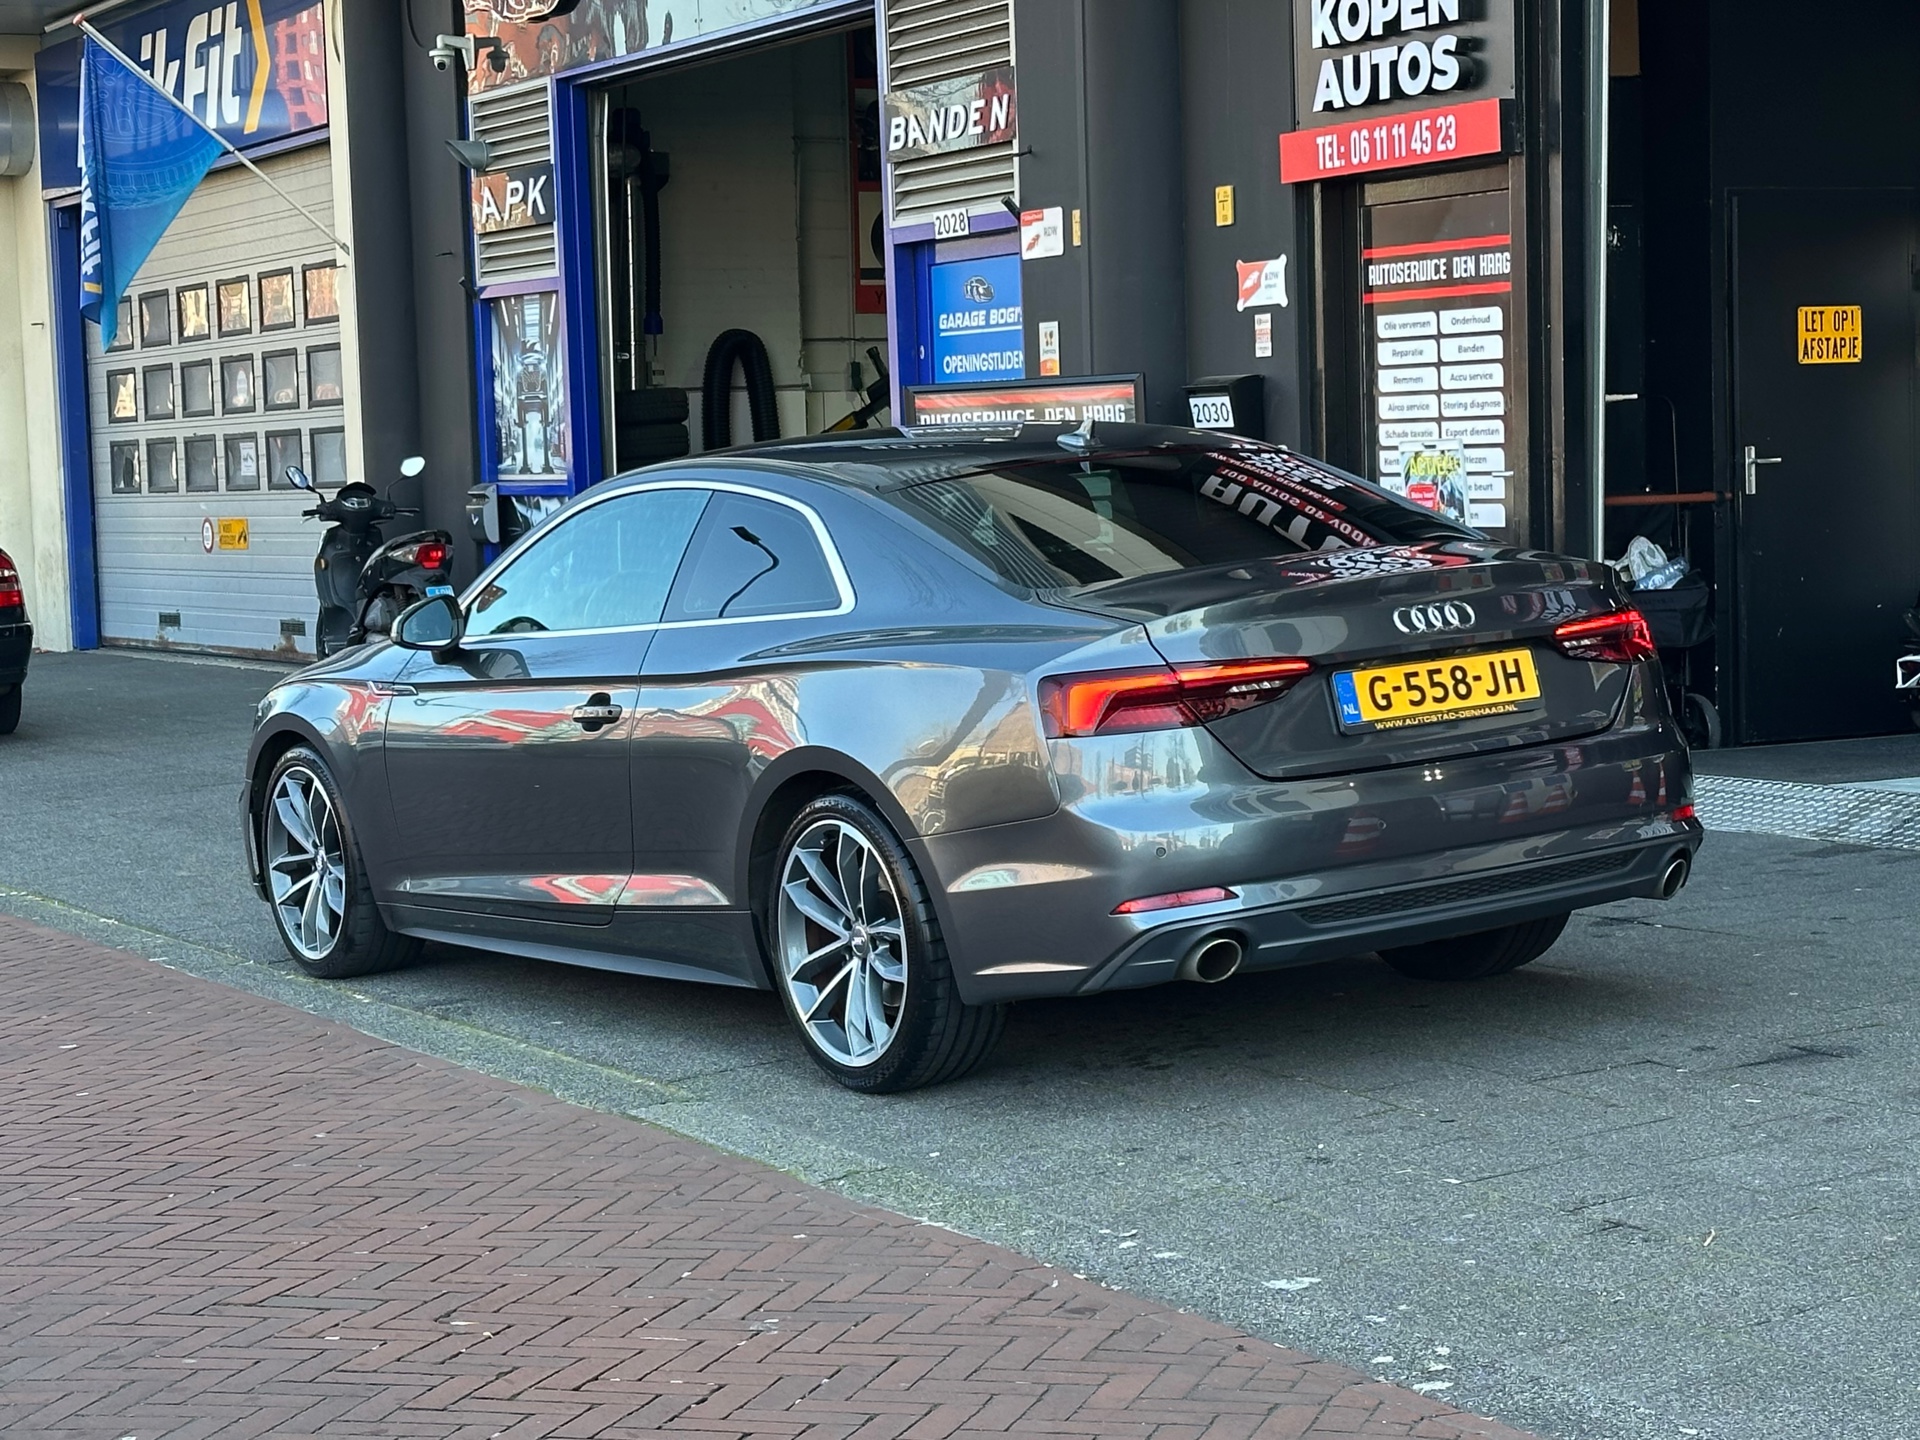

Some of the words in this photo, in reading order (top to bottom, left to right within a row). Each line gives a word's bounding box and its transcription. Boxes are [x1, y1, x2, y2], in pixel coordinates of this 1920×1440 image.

[1311, 0, 1459, 48] KOPEN
[1312, 34, 1460, 113] AUTOS
[889, 94, 1009, 151] BANDEN
[1316, 134, 1346, 170] TEL:
[1350, 128, 1370, 166] 06
[1373, 125, 1388, 161] 11
[1391, 122, 1406, 158] 11
[1410, 118, 1432, 155] 45
[1436, 114, 1457, 152] 23
[481, 175, 547, 224] APK
[935, 211, 967, 236] 2028
[1368, 258, 1447, 286] AUTOSERVICE
[1452, 253, 1476, 279] DEN
[1479, 251, 1511, 276] HAAG
[939, 309, 986, 330] GARAGE
[1383, 321, 1397, 331] Olie
[1398, 320, 1431, 330] verversen
[1451, 315, 1491, 326] Onderhoud
[1804, 310, 1825, 332] LET
[1833, 309, 1854, 332] OP!
[1391, 348, 1424, 359] Reparatie
[1457, 344, 1485, 354] Banden
[1802, 336, 1859, 360] AFSTAPJE
[943, 350, 1024, 374] OPENINGSTIJDEN
[1393, 375, 1423, 385] Remmen
[1450, 373, 1468, 382] Accu
[1469, 371, 1493, 381] service
[1044, 407, 1076, 422] DEN
[1083, 404, 1126, 423] HAAG
[1193, 402, 1230, 423] 2030
[1387, 403, 1405, 412] Airco
[1406, 402, 1430, 411] service
[1443, 401, 1468, 411] Storing
[1469, 399, 1501, 411] diagnose
[1385, 430, 1409, 439] Schade
[1445, 428, 1470, 438] Export
[1470, 427, 1500, 437] diensten
[1474, 482, 1493, 492] beurt
[1368, 658, 1526, 712] G-558-JH
[1343, 703, 1359, 715] NL
